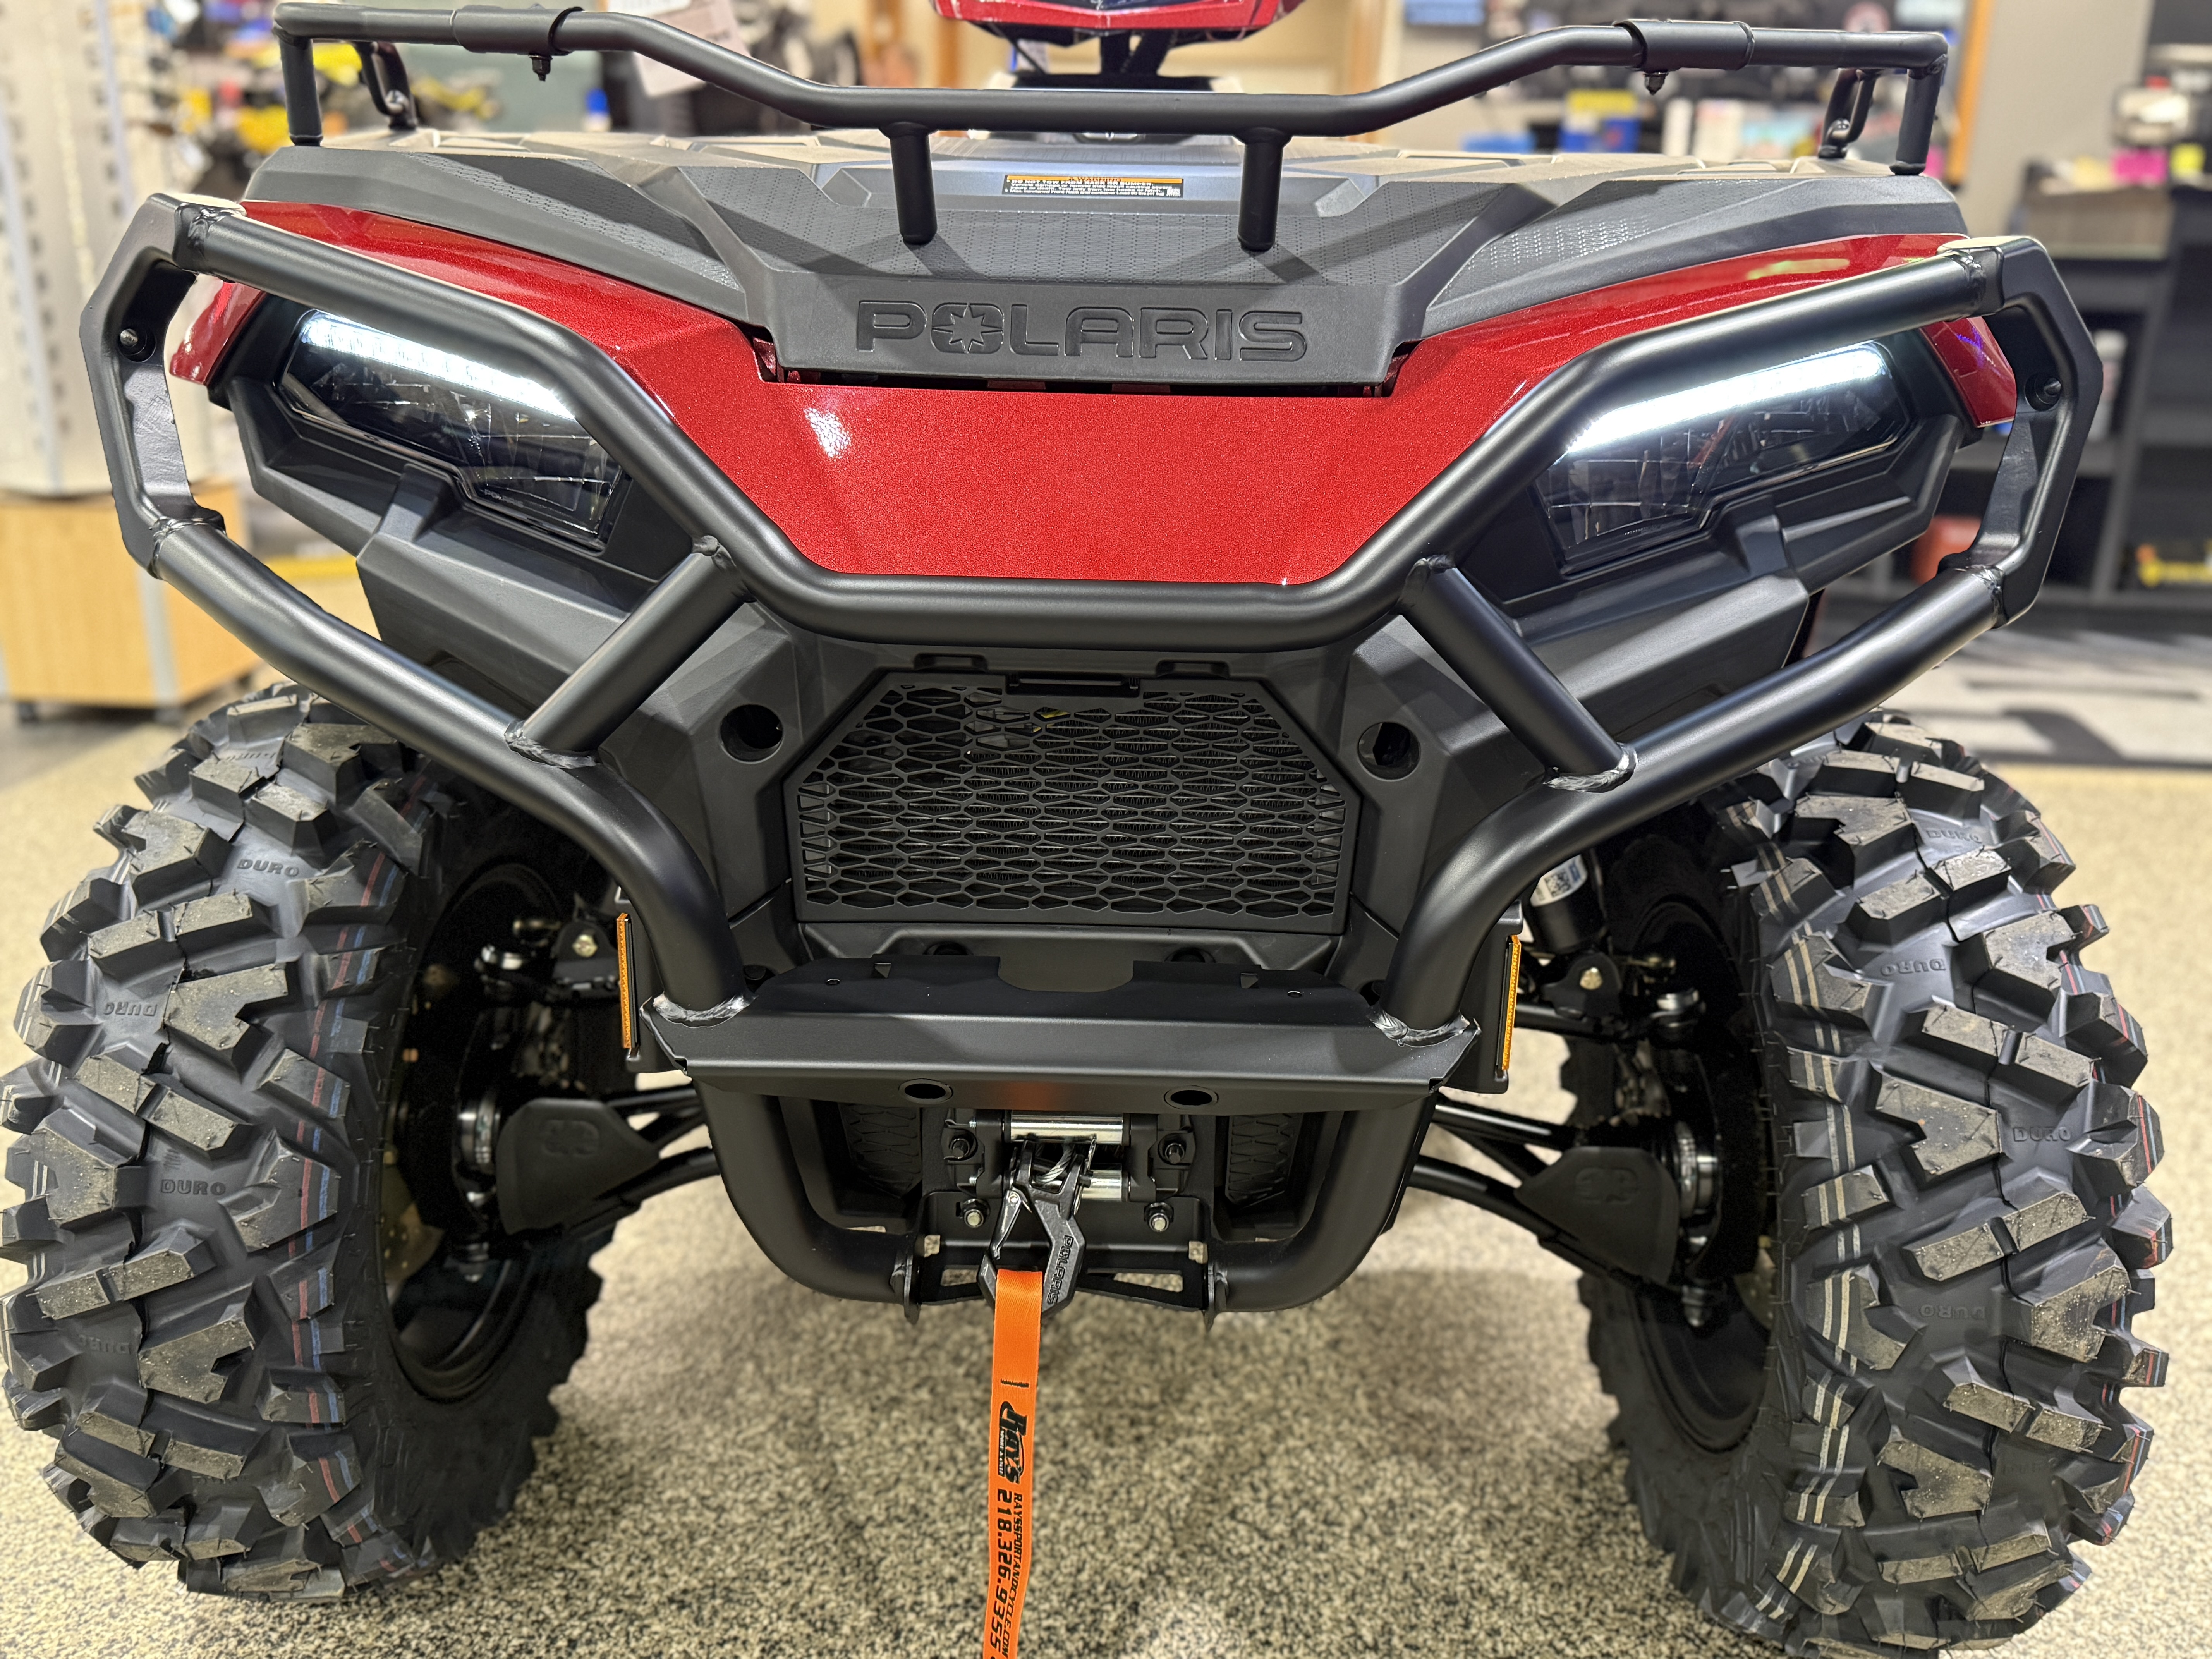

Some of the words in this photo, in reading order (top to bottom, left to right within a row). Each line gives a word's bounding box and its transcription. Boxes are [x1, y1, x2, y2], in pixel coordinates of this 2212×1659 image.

[856, 300, 1307, 362] POLARIS
[237, 859, 299, 878] DURO
[1880, 958, 1946, 977] DURO
[103, 1001, 158, 1017] DURO
[2013, 1127, 2071, 1142] DURO
[161, 1179, 226, 1196] DURO
[1046, 1234, 1074, 1305] POLARIS
[1919, 1304, 1986, 1320] DURO
[990, 1488, 1012, 1653] 218.326.9355
[1002, 1492, 1023, 1658] RAYSSPORTANDCYCLE.COM
